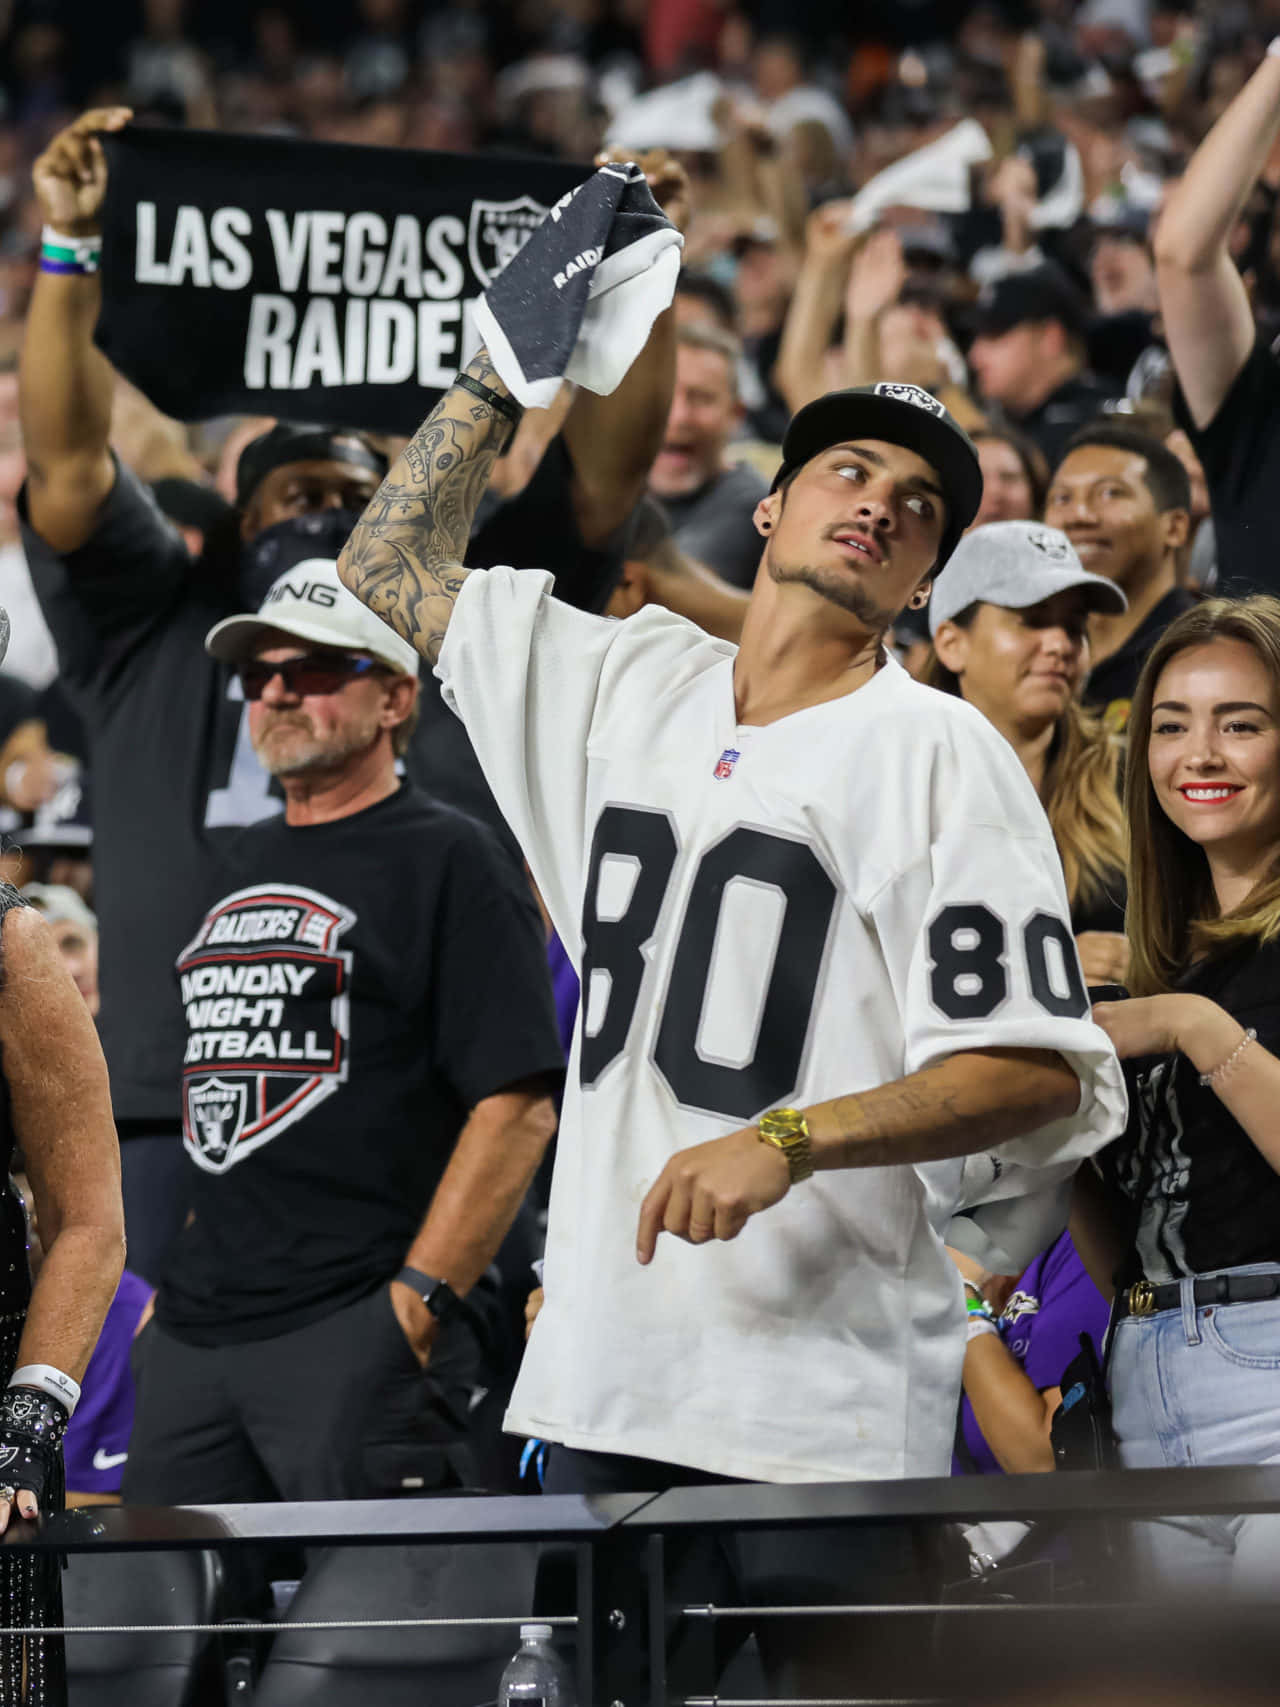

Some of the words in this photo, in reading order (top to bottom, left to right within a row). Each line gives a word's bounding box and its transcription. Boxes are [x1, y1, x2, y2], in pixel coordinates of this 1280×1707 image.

[134, 201, 254, 291] LAS
[266, 208, 466, 301] VEGAS
[580, 800, 847, 1125] 80
[923, 901, 1093, 1023] 80
[183, 1030, 333, 1065] OTBALL
